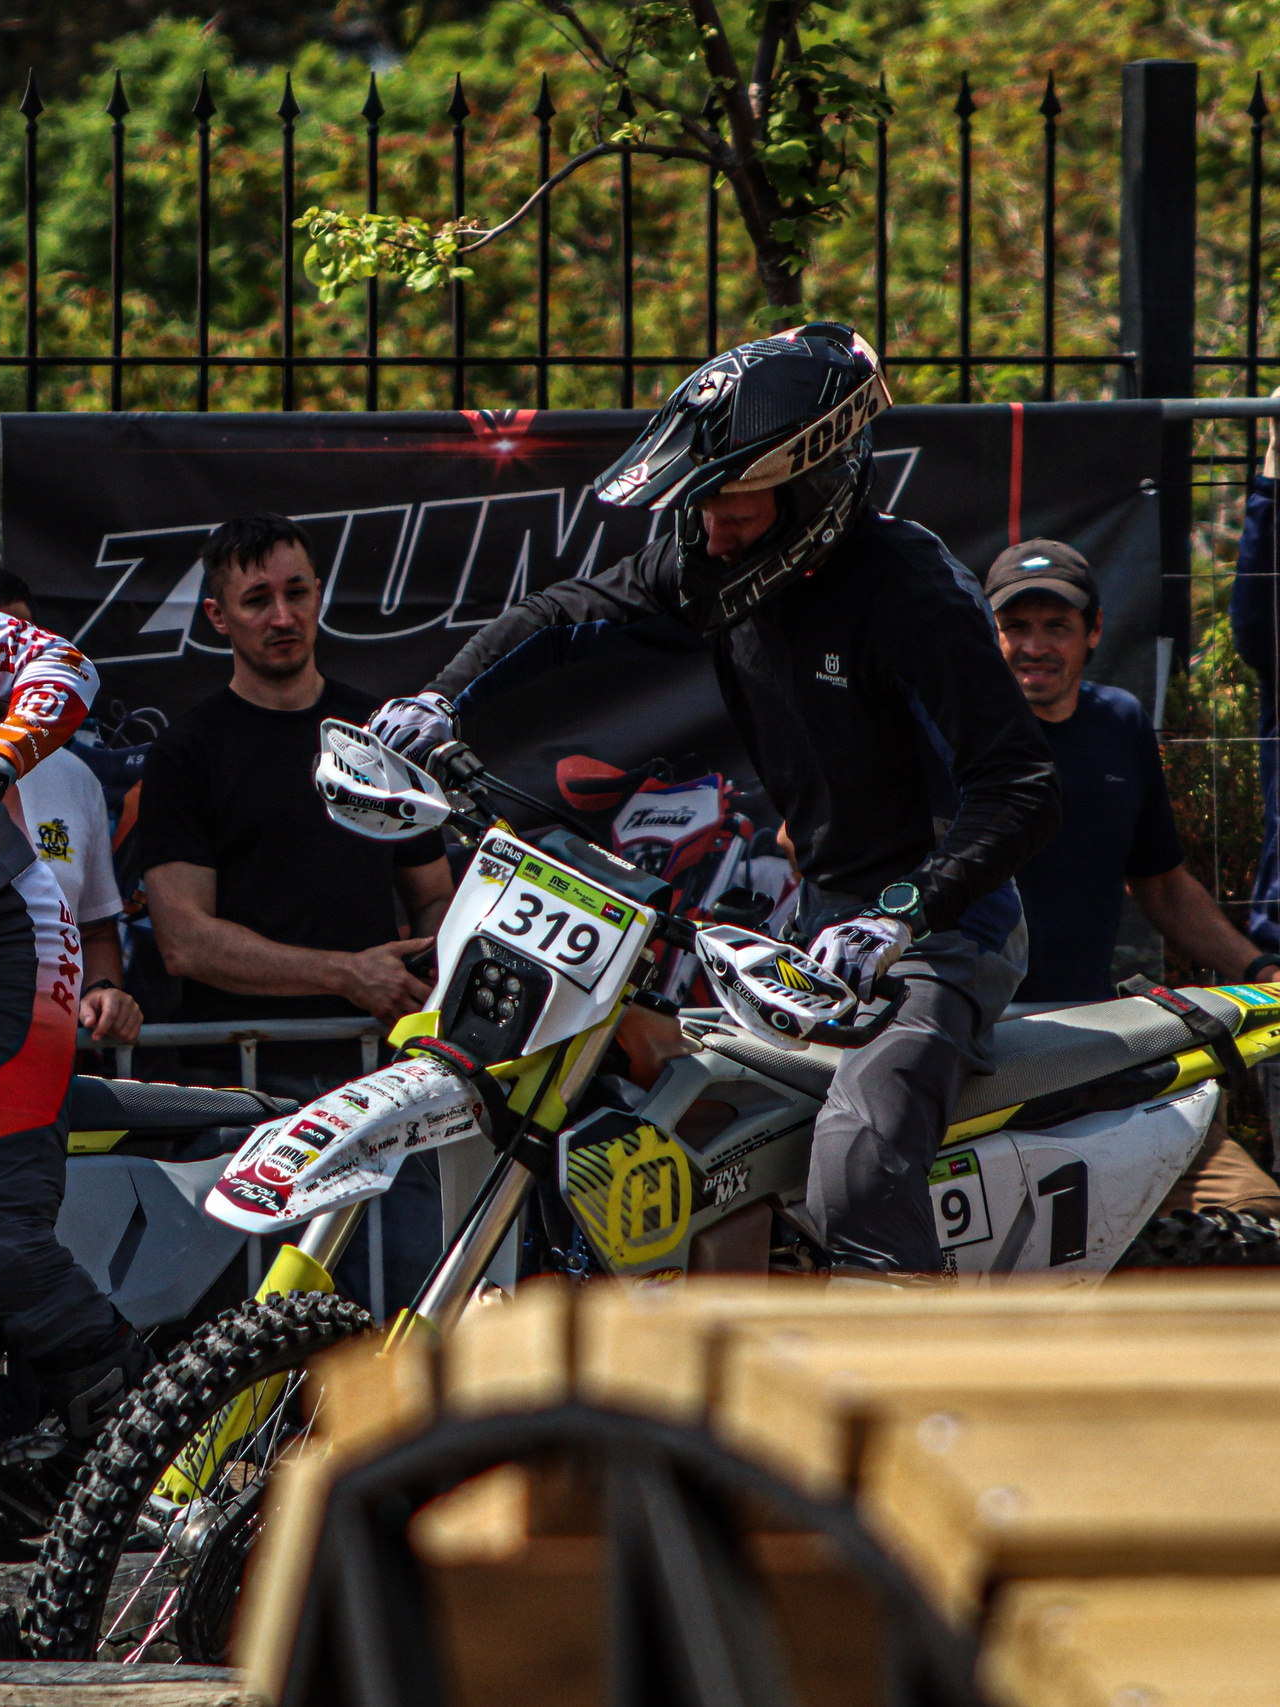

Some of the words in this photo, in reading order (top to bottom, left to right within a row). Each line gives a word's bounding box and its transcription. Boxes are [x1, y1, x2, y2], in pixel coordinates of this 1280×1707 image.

[786, 386, 879, 475] 100%
[348, 795, 386, 811] CYCRA
[497, 892, 601, 966] 319
[733, 980, 763, 1010] CYCRA
[299, 1126, 326, 1141] LAVR
